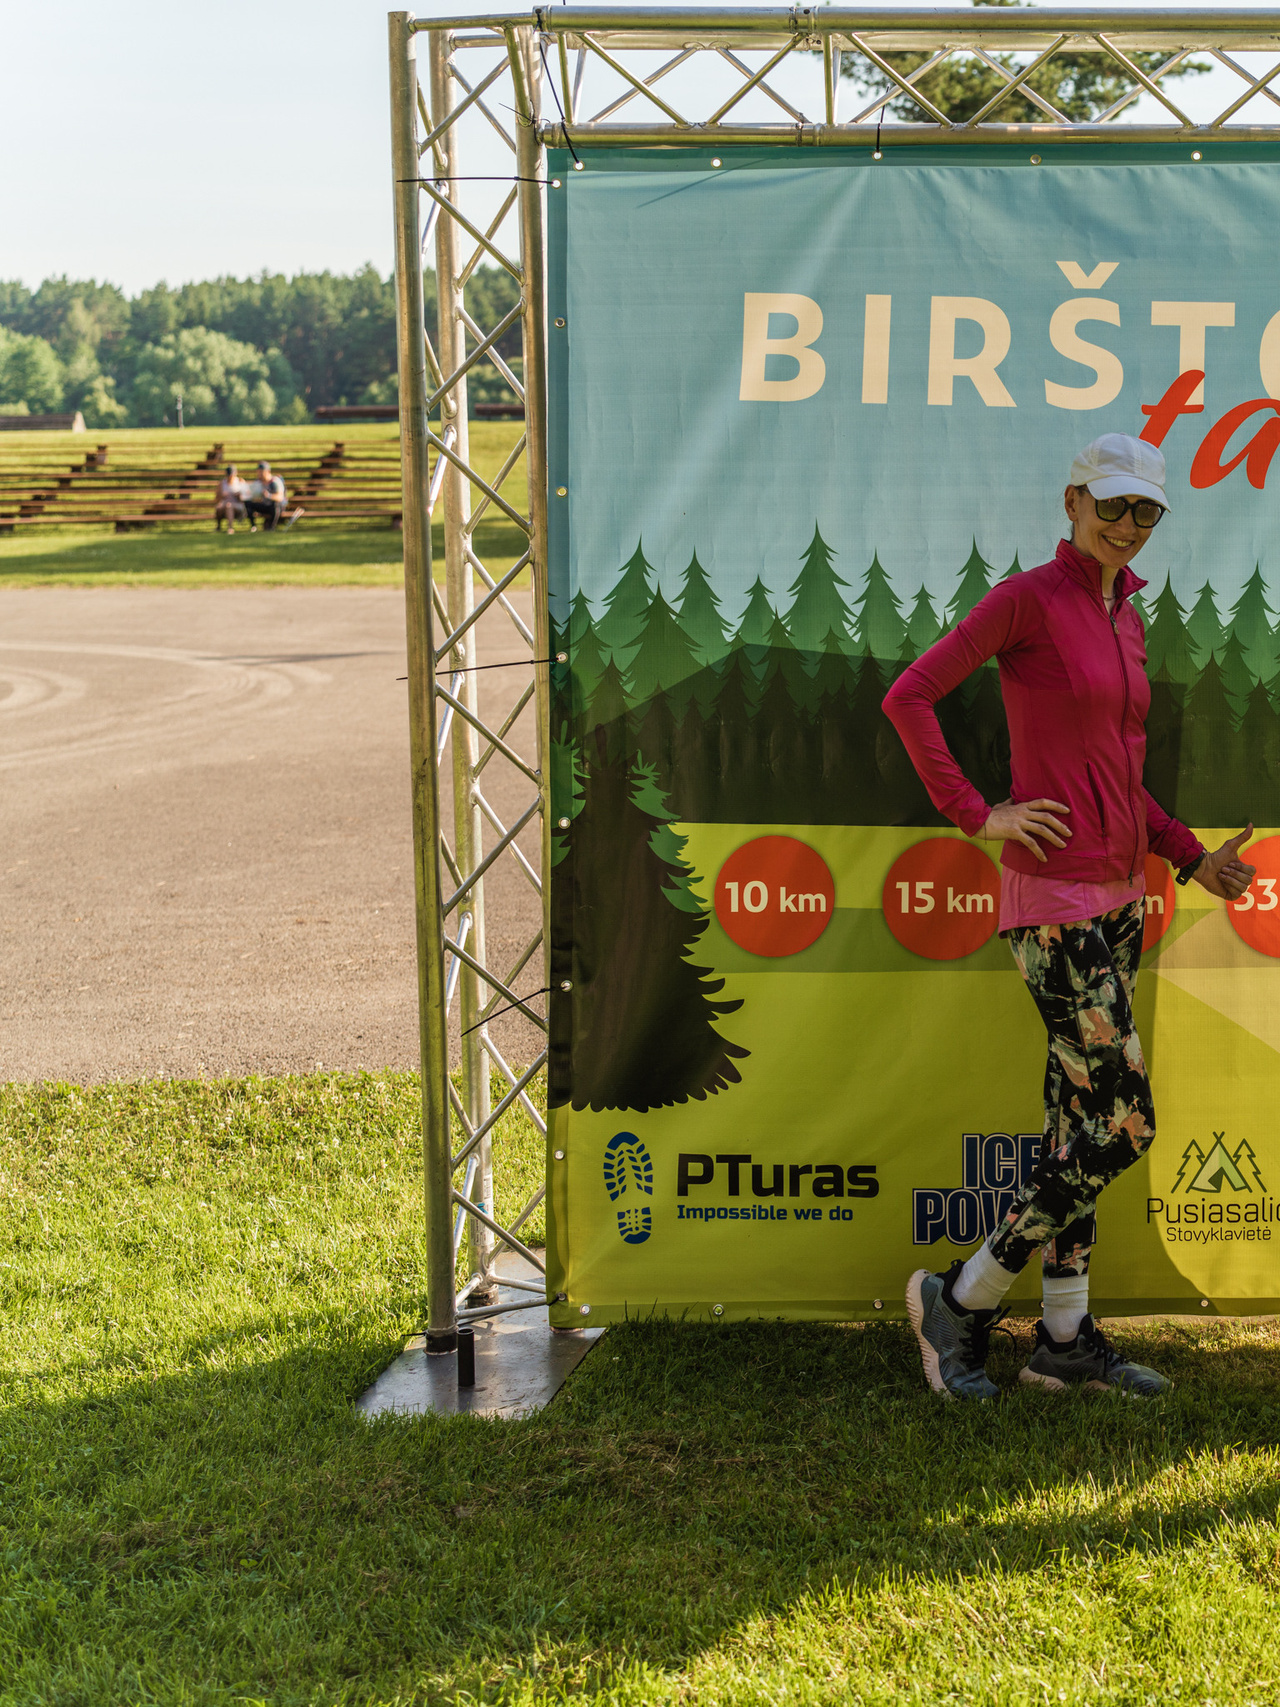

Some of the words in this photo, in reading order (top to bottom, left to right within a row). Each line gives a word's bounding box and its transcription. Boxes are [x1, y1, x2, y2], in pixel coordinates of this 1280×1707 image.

[725, 880, 769, 913] 10
[779, 887, 827, 913] km
[896, 881, 936, 914] 15
[947, 887, 994, 913] km
[1233, 878, 1279, 911] 33
[677, 1153, 880, 1199] PTuras
[677, 1204, 788, 1222] Impossible
[793, 1208, 823, 1221] we
[828, 1205, 854, 1221] do
[1166, 1226, 1272, 1245] Stovyklavietė
